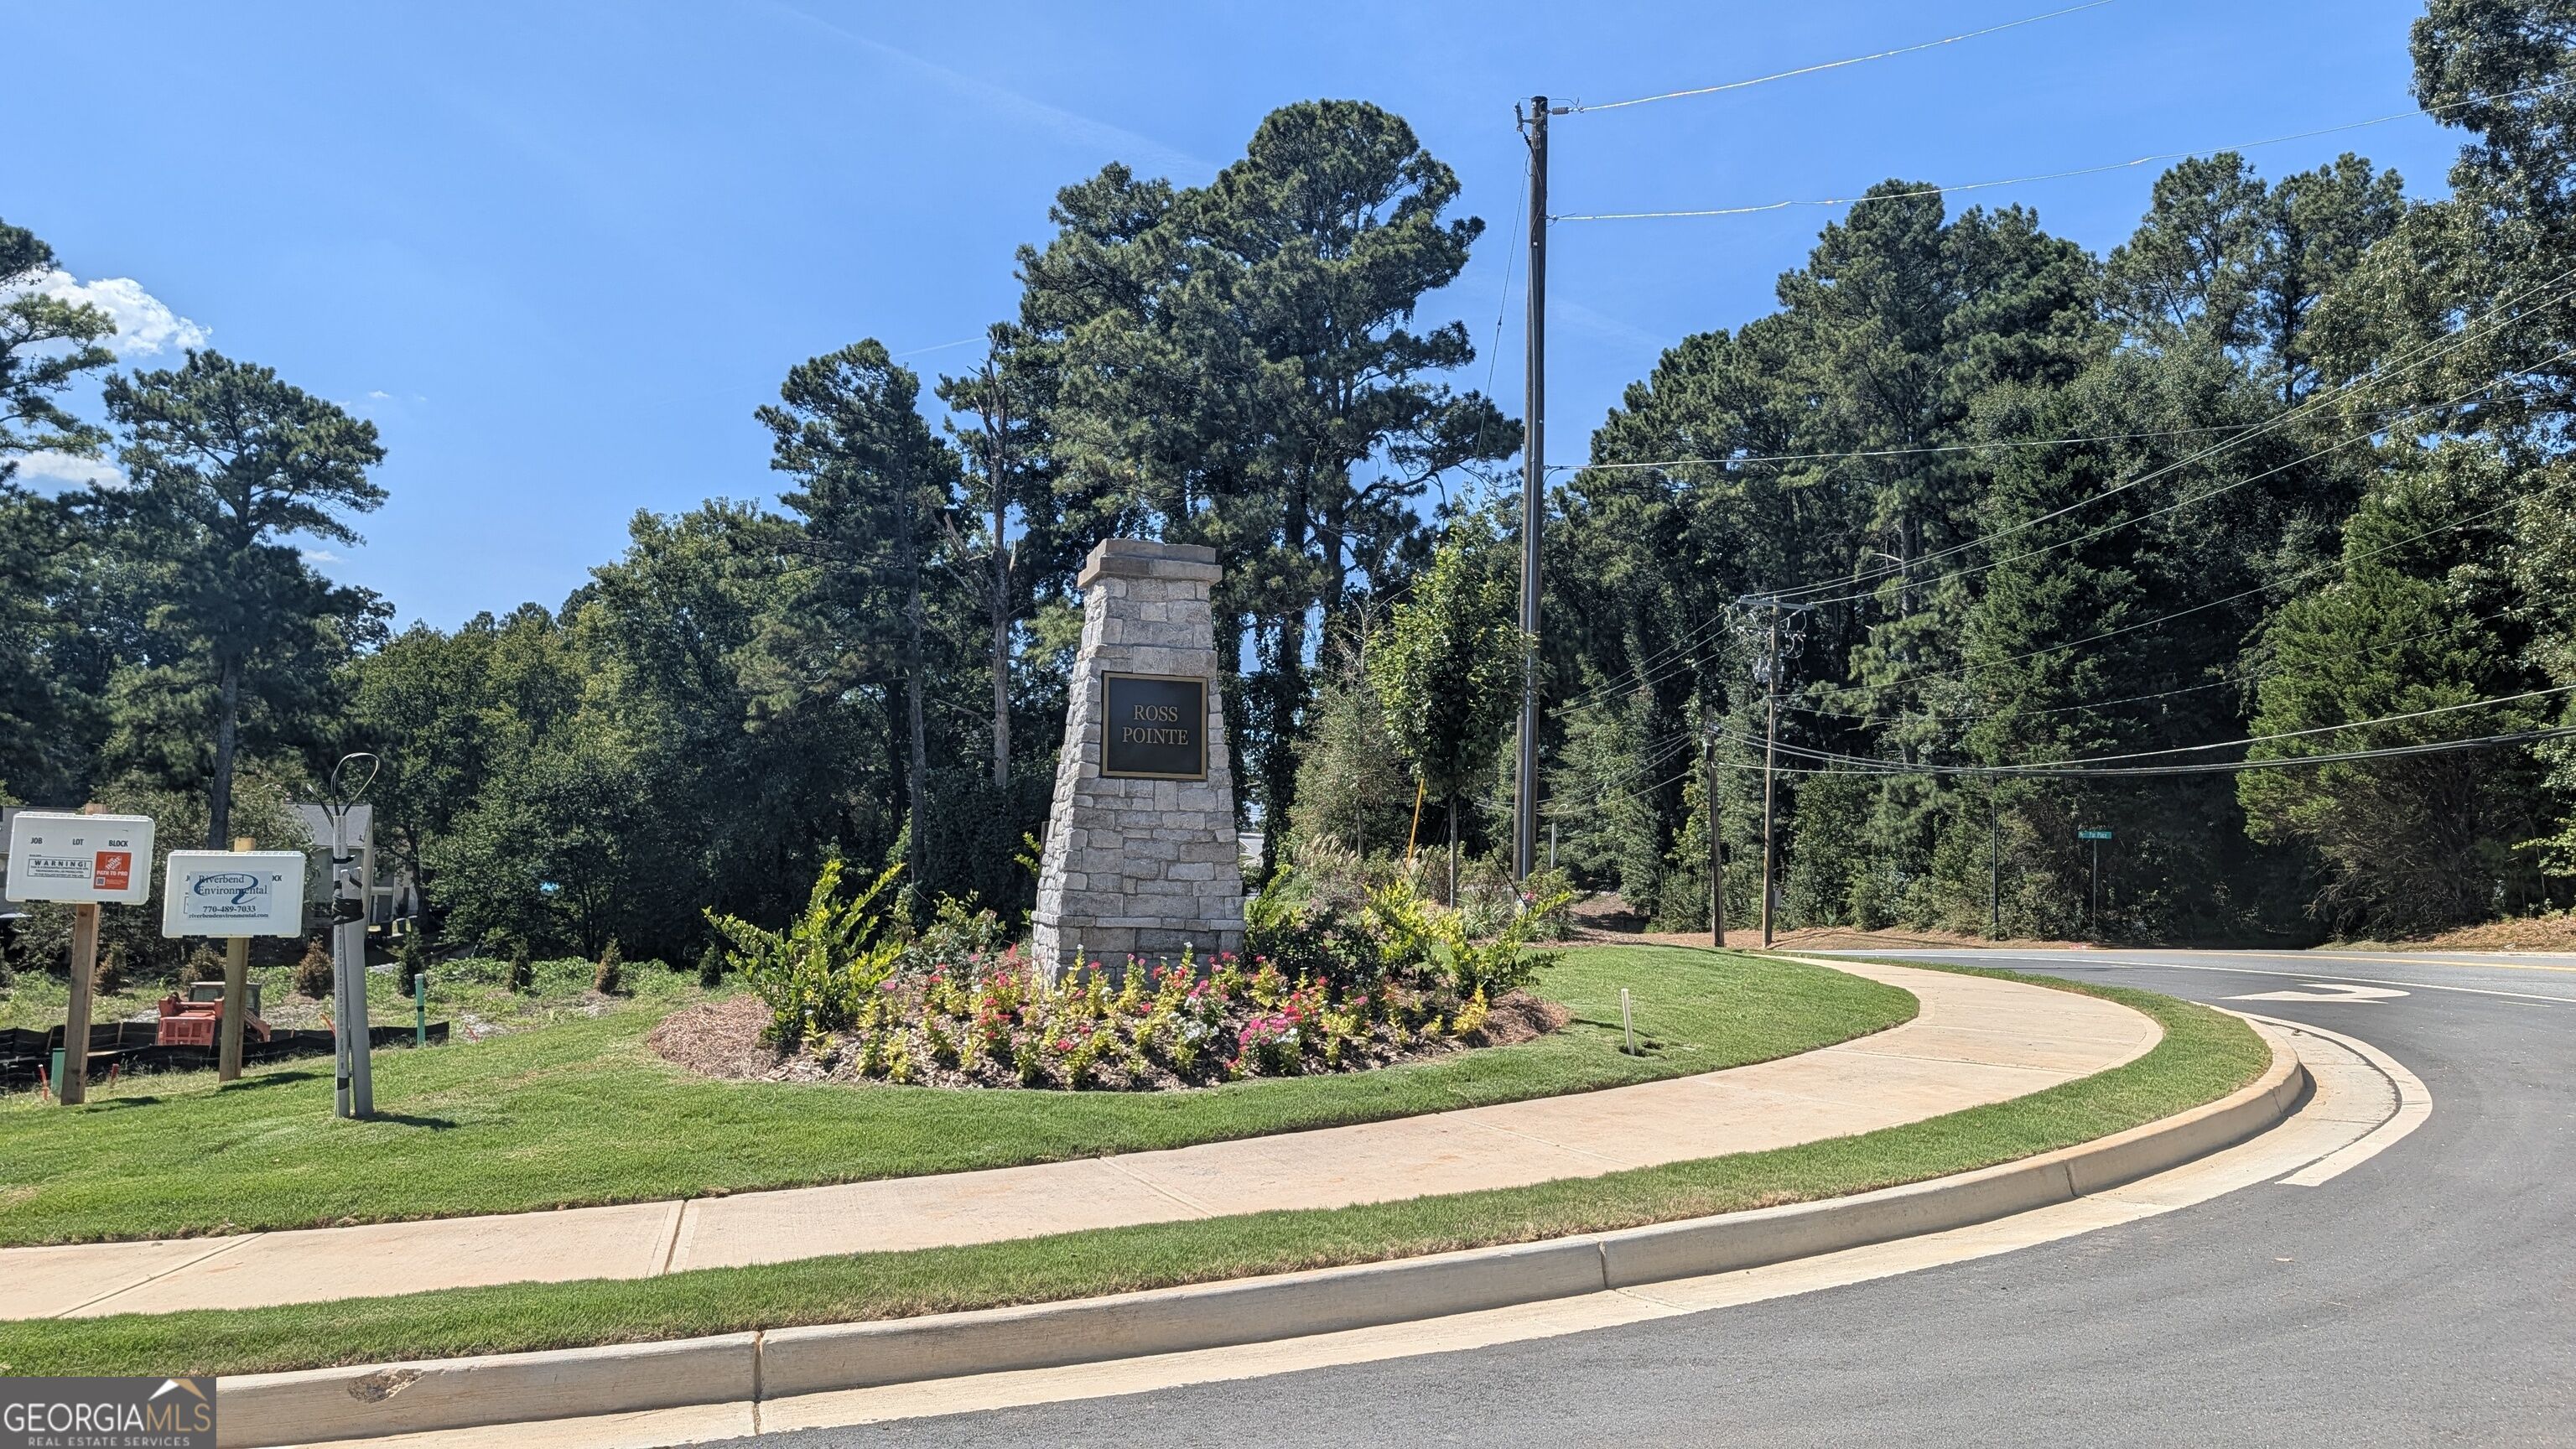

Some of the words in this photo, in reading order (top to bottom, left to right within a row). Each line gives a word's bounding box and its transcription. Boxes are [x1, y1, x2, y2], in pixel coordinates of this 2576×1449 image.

[1133, 704, 1178, 722] ROSS
[1122, 726, 1188, 745] POINTE
[198, 874, 245, 884] Riverbend
[198, 885, 268, 895] Environmental
